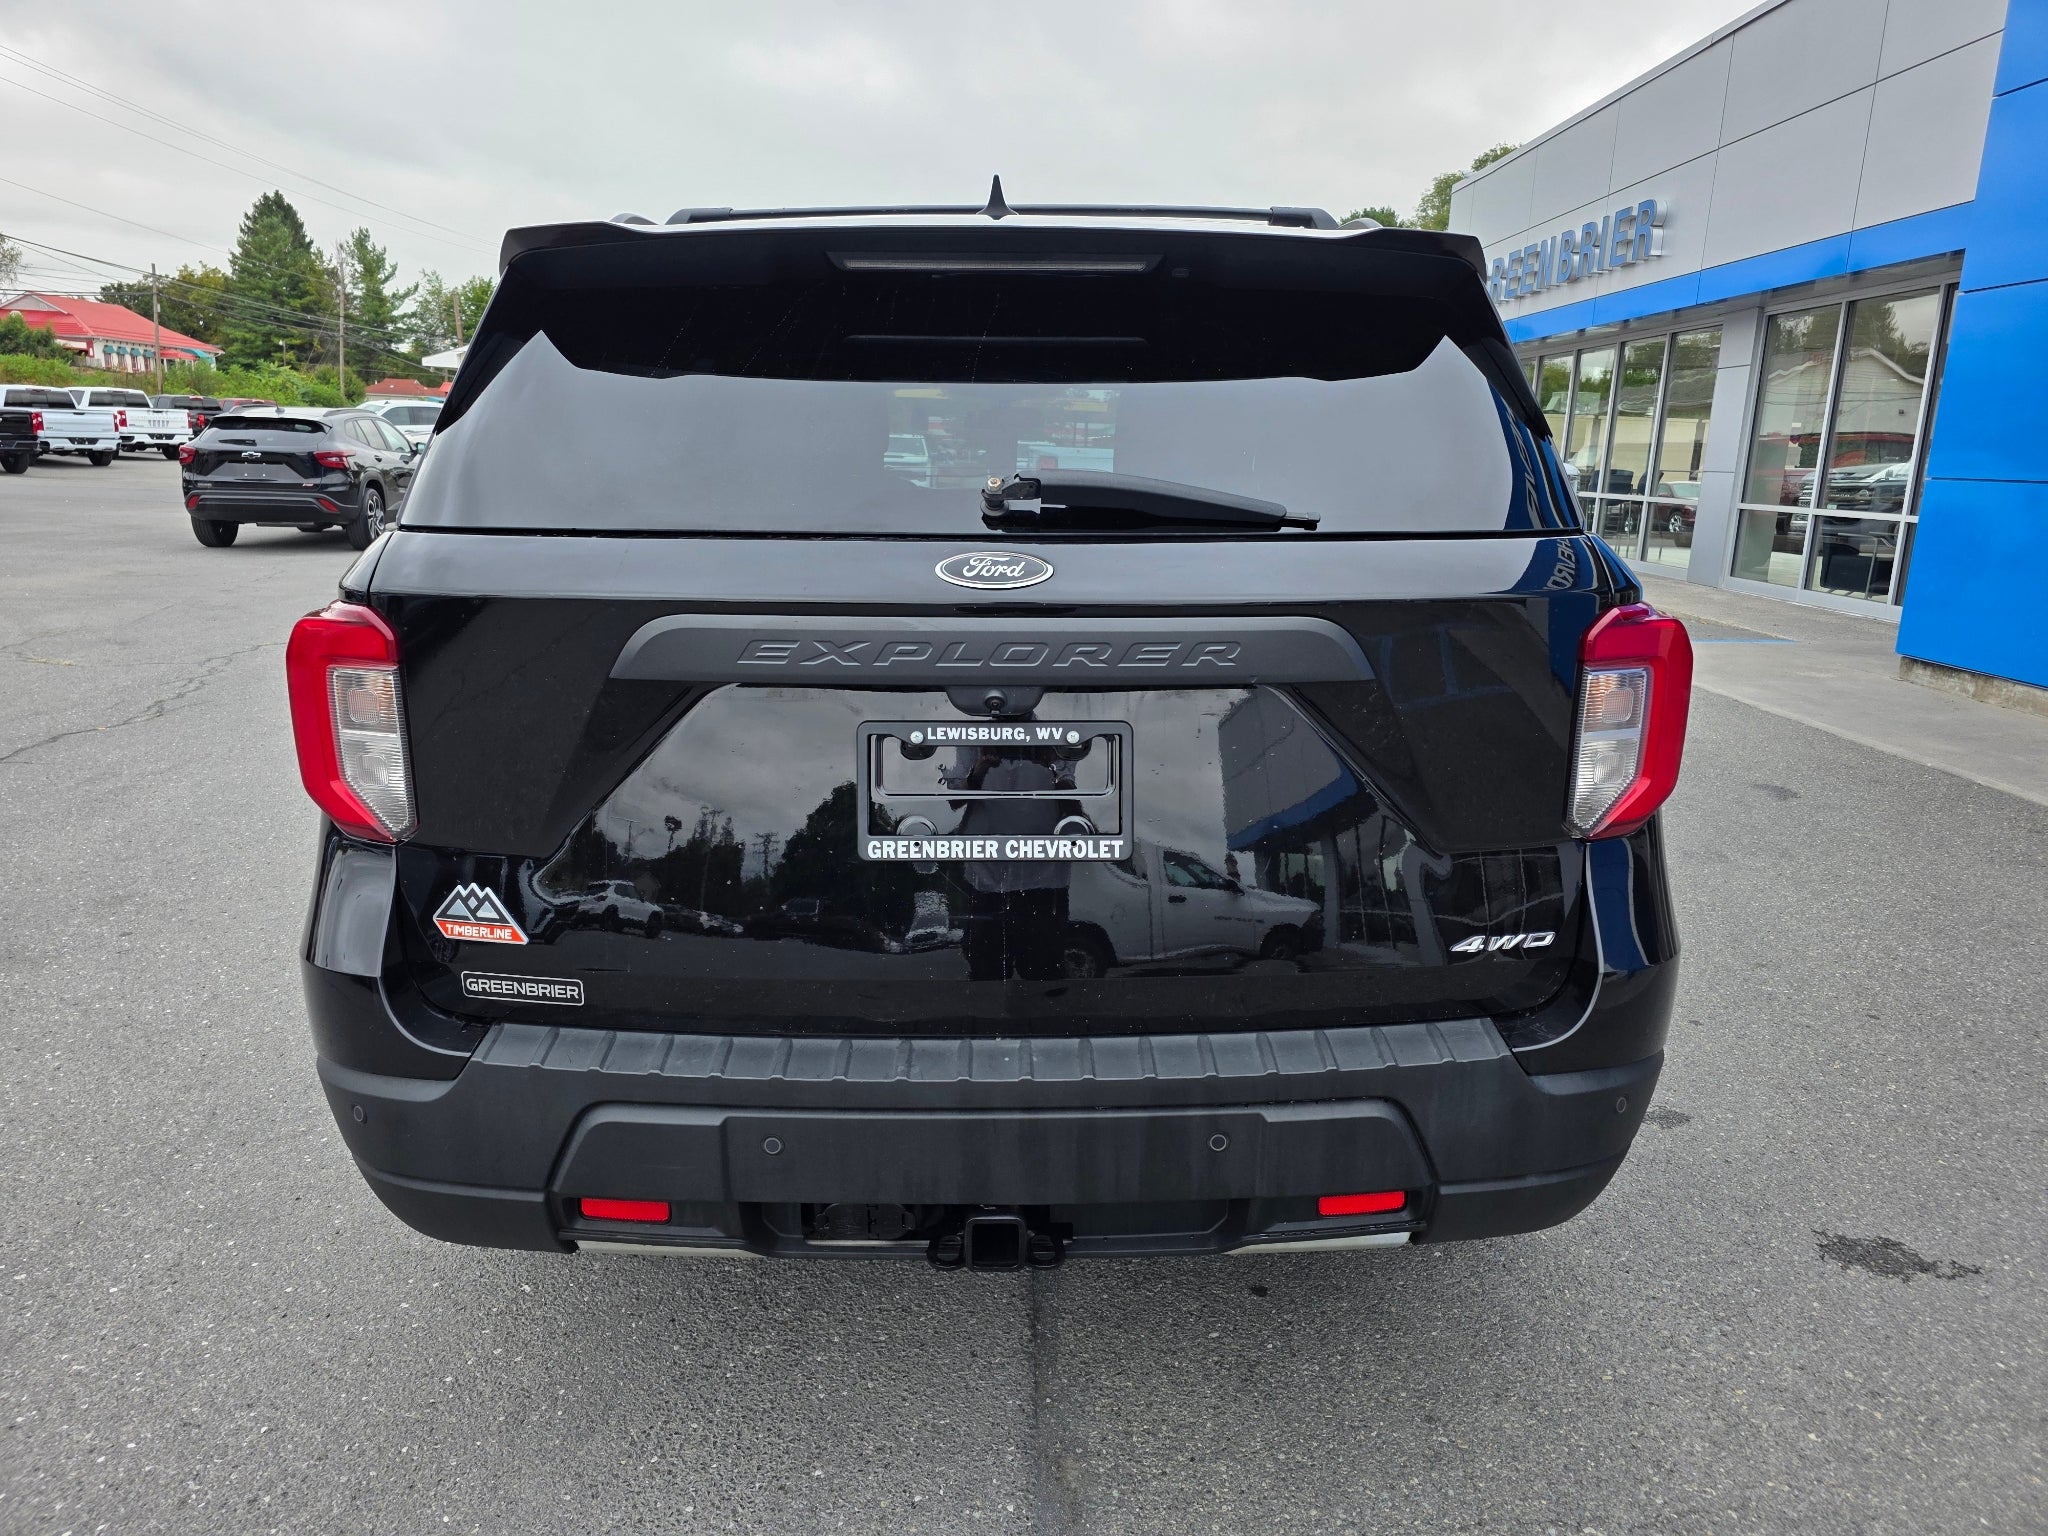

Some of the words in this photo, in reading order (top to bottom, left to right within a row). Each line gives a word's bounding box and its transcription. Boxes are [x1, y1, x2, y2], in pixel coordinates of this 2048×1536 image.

[1488, 199, 1664, 303] REENBRIER
[962, 556, 1027, 577] Ford
[737, 639, 1242, 667] EXPLORER
[927, 727, 1031, 742] LEWISBURG,
[1036, 727, 1063, 740] WV
[867, 840, 999, 859] GREENBRIER
[1005, 839, 1124, 859] CHEVROLET
[445, 924, 513, 940] TIMBERLINE
[1449, 931, 1556, 952] 4WD
[466, 978, 580, 999] GREENBRIER
